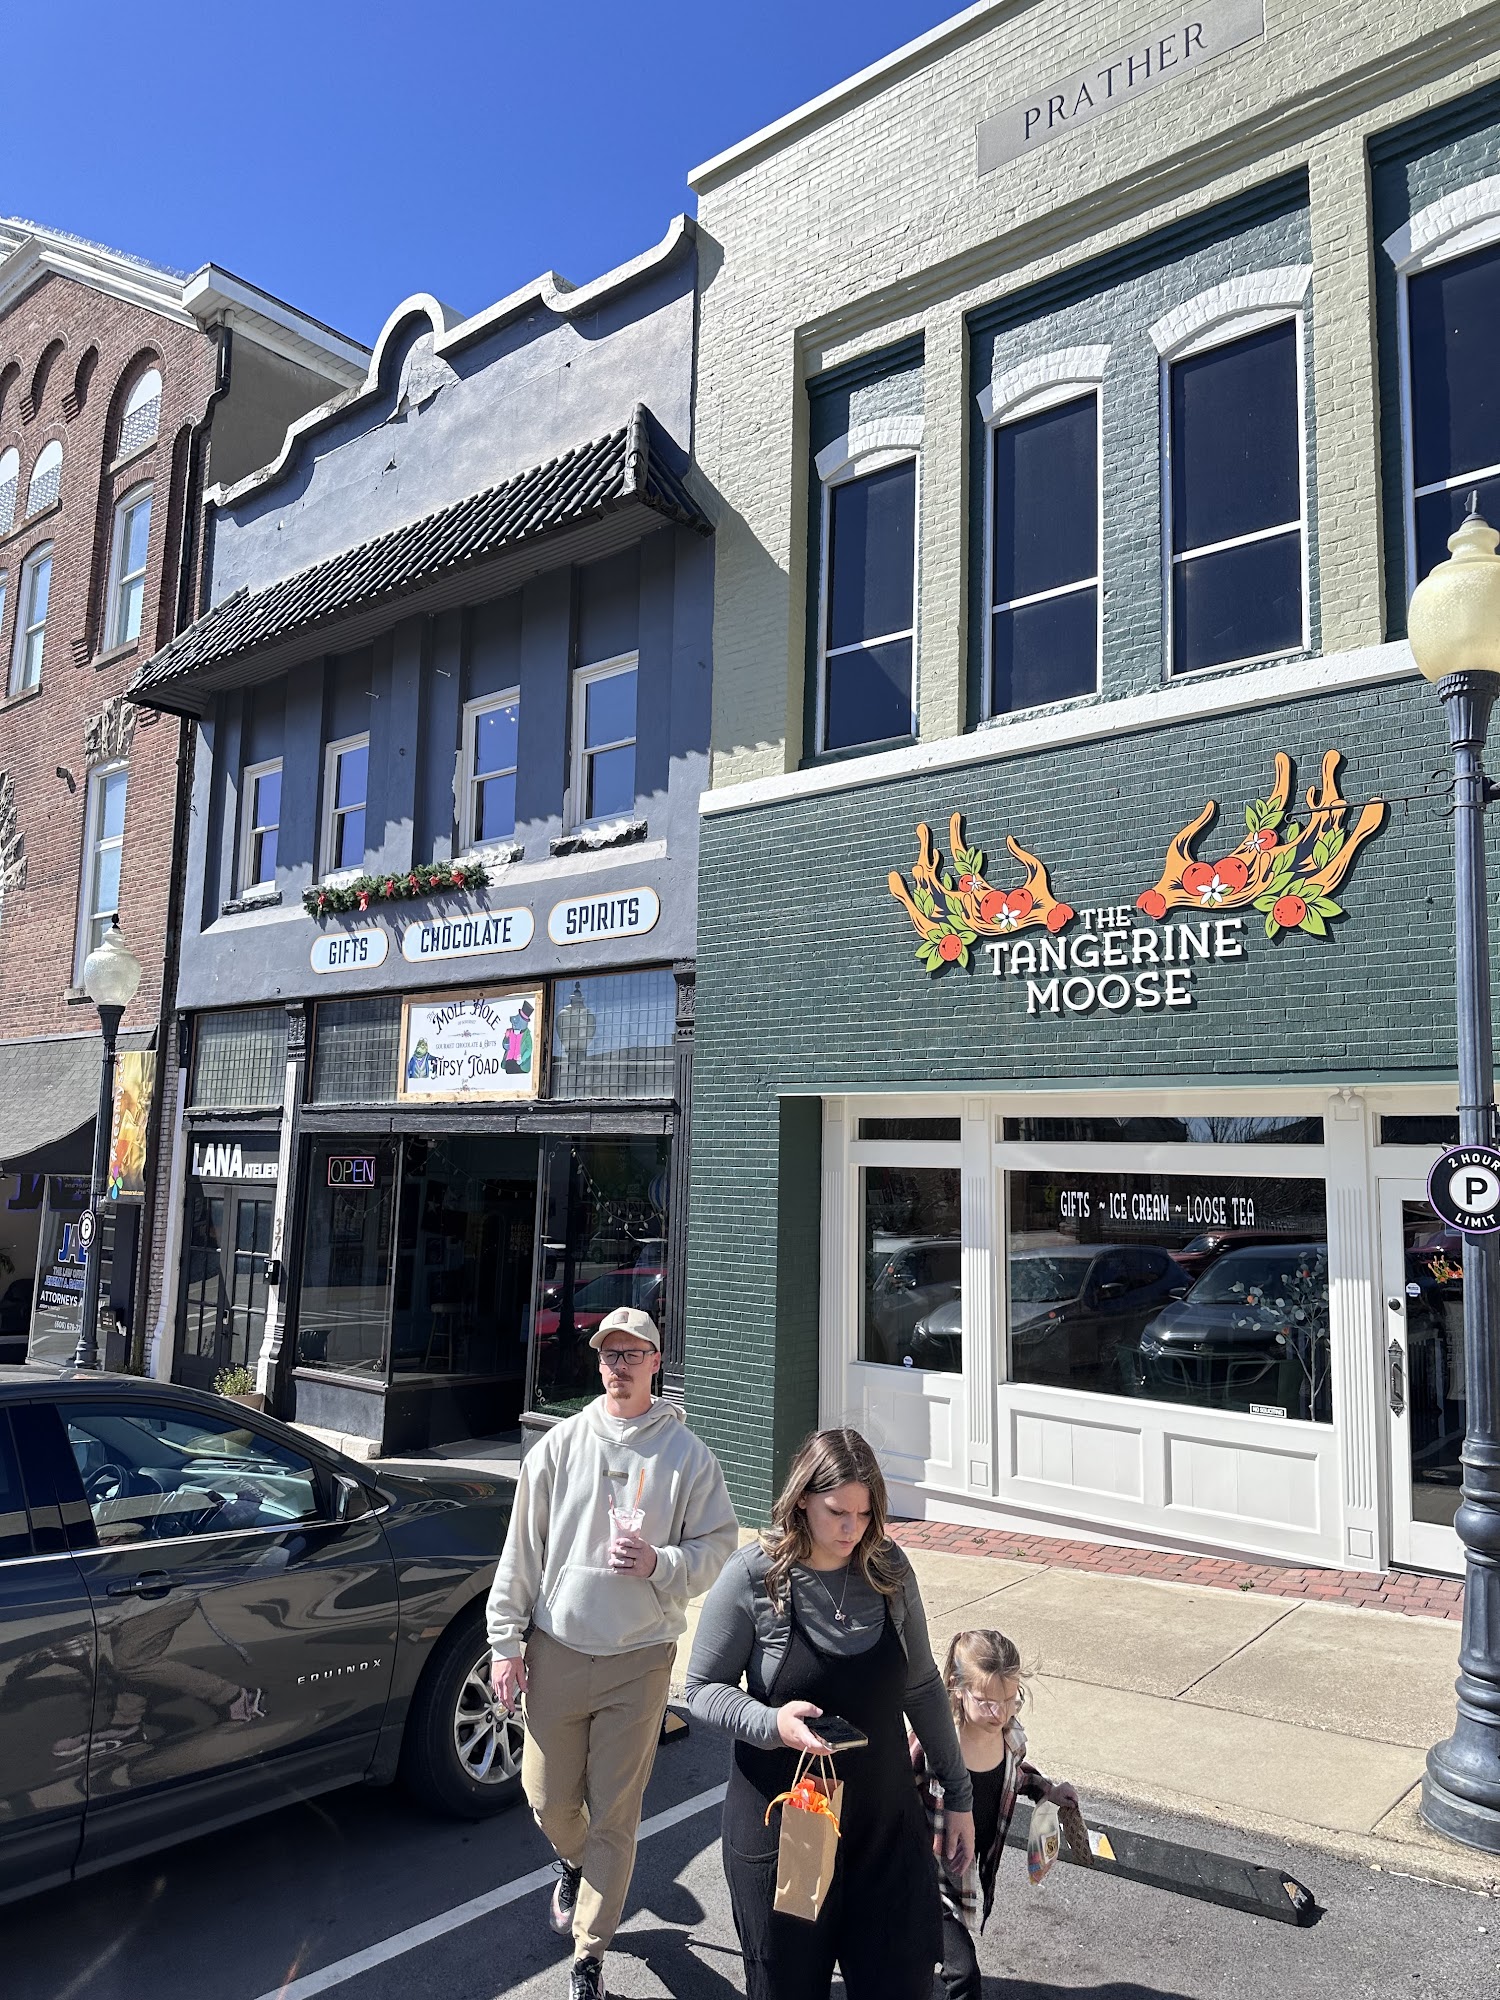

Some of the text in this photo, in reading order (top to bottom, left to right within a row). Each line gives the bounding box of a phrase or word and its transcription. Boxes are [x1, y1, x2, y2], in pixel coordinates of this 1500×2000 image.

[1023, 22, 1208, 141] PRATHER
[566, 897, 640, 935] SPIRITS
[1080, 905, 1132, 930] THE
[420, 917, 513, 953] CHOCOLATE
[985, 919, 1243, 975] TANGERINE
[328, 937, 369, 965] GIFTS
[1027, 968, 1193, 1014] MOOSE
[432, 1000, 466, 1035] MOLE
[470, 998, 502, 1031] HOLE
[430, 1054, 500, 1080] TIPSY TOAD
[191, 1142, 279, 1179] LANA ATELIER
[330, 1160, 375, 1182] OPEN
[1447, 1153, 1500, 1171] 2 HOUR
[1465, 1177, 1488, 1205] P
[1060, 1191, 1090, 1218] GIFTS
[1109, 1192, 1127, 1220] ICE
[1131, 1193, 1170, 1222] CREAM
[1186, 1195, 1227, 1225] LOOSE
[1232, 1197, 1255, 1226] TEA
[1455, 1212, 1496, 1228] LIMIT
[40, 1290, 78, 1307] ATTORNEYS
[297, 1658, 381, 1685] EQUINOX
